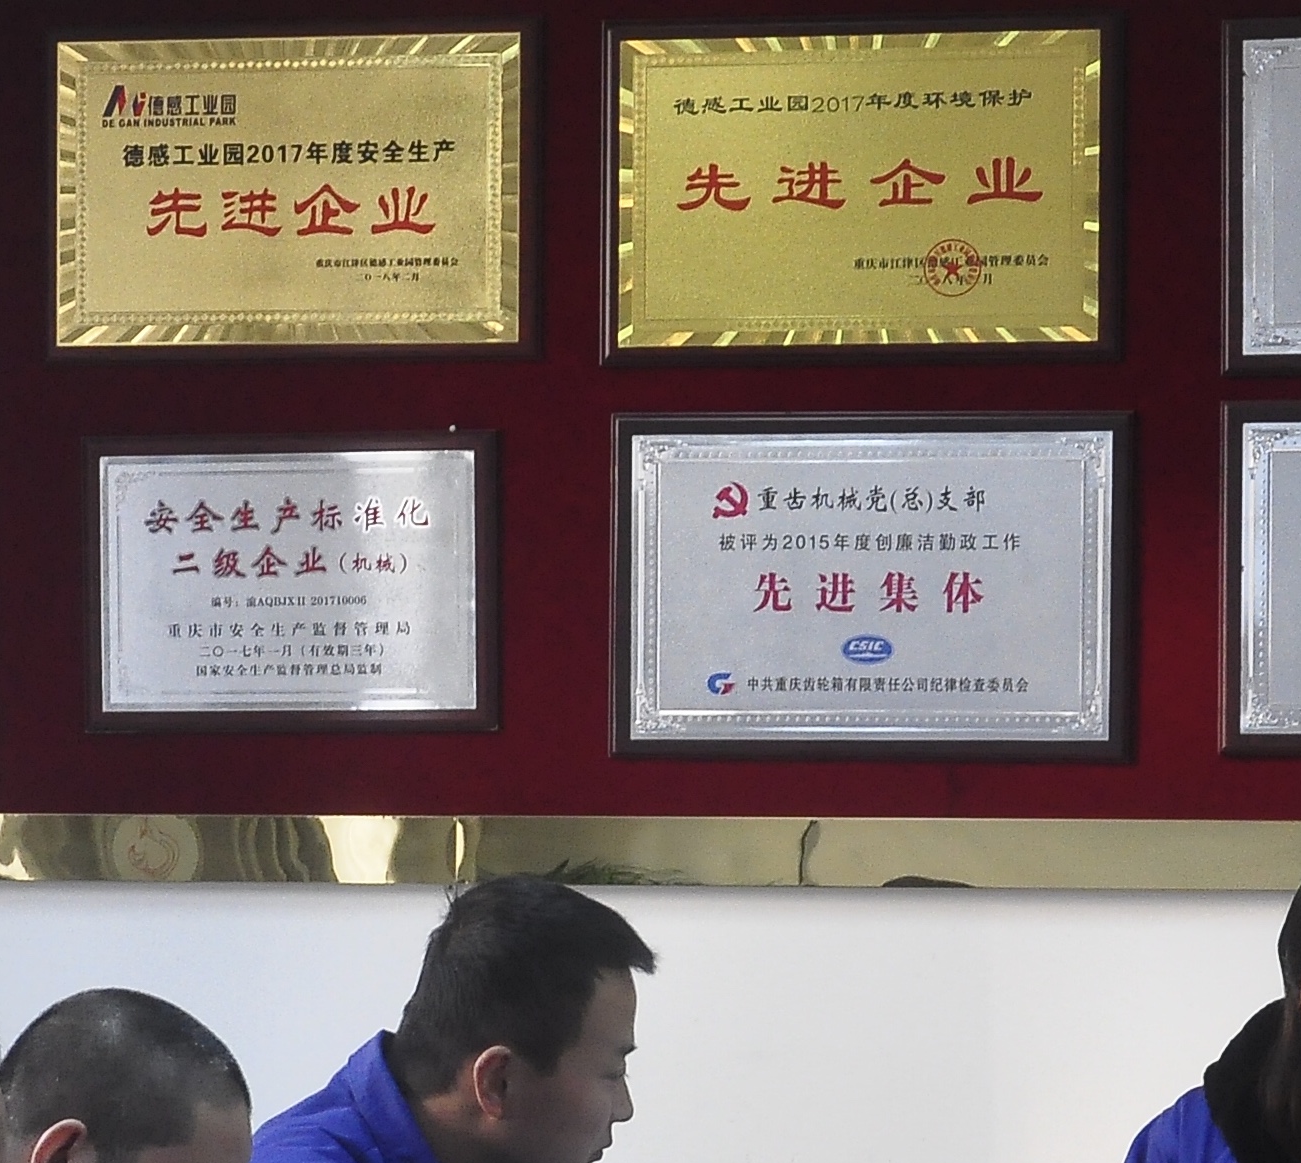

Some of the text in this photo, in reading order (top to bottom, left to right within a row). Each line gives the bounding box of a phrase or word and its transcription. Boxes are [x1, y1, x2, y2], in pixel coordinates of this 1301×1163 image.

[148, 94, 236, 116] 德感工业园
[674, 88, 1033, 116] 德感工业园2017年度环境保护
[144, 118, 205, 127] INDUSTRIAL
[209, 116, 236, 127] PARK
[122, 139, 456, 167] 德感工业园2017年度安全生产
[677, 157, 1044, 211] 先进企业
[146, 183, 436, 237] 先进企业
[145, 496, 431, 535] 安全生产标准化
[719, 532, 1021, 552] 被评为2015年度创廉洁勤政工作
[753, 571, 984, 614] 先进集体
[168, 621, 411, 638] 重庆市安全生产监督管理局
[848, 639, 885, 653] CSIC
[196, 663, 382, 676] 国家安全生产监督管理总局监制
[747, 676, 1028, 693] 中共重庆齿轮箱有限责任公司纪律检查委员会
